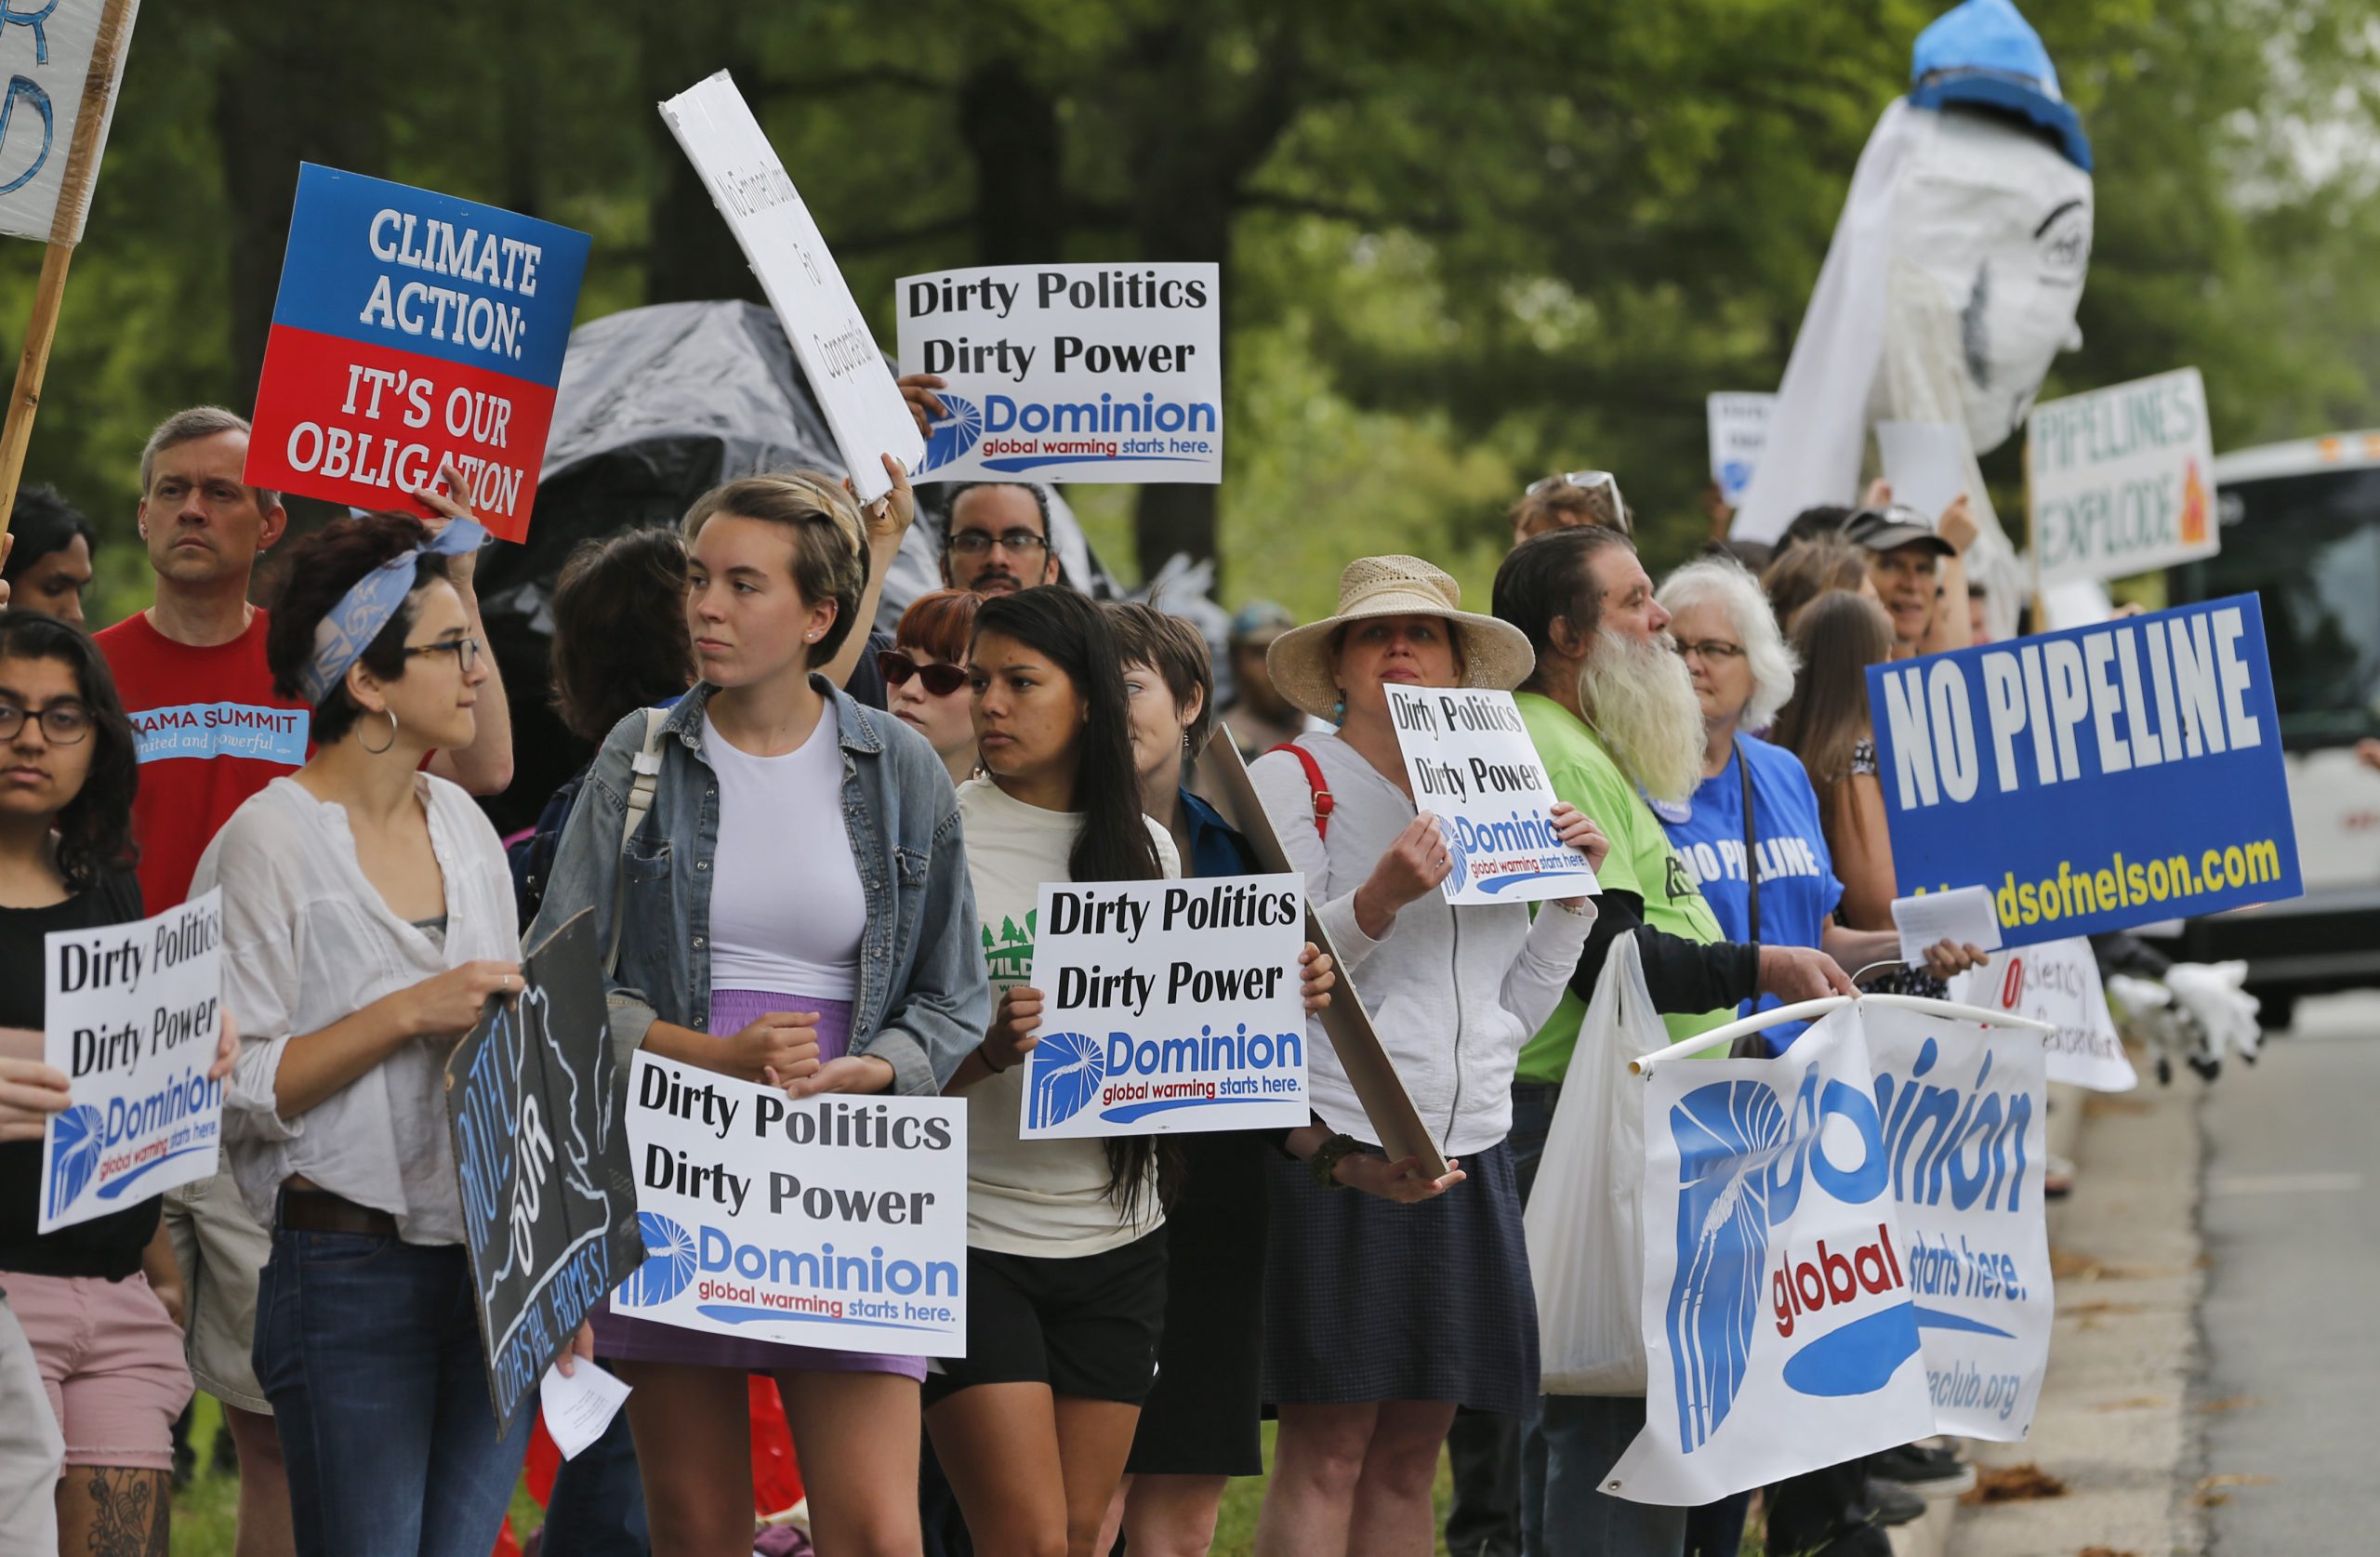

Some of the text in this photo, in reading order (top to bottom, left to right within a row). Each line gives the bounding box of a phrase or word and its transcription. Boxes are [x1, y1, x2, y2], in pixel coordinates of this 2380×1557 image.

[369, 207, 543, 298] CLIMATE
[360, 275, 526, 361] ACTION:
[907, 270, 1209, 319] Dirty Politics
[922, 336, 1037, 383] Dirty
[1053, 336, 1197, 374] Power
[341, 363, 512, 449] IT'S OUR
[983, 392, 1216, 433] Dominion
[286, 421, 524, 518] OBLIGATION
[983, 438, 1214, 457] global warming starts here.
[204, 707, 298, 734] SUMMIT
[1392, 693, 1523, 742] Dirty Politics
[1882, 606, 2262, 811] NO PIPELINE
[136, 732, 273, 754] nited and powerful
[1414, 757, 1543, 804] Dirty Power
[1454, 809, 1564, 854] Dominio
[1675, 837, 1820, 886] NO PILINE
[1470, 852, 1587, 878] global warming starts here.
[1913, 838, 2281, 929] dsofnelson.com
[1049, 883, 1297, 944] Dirty Politics
[60, 909, 219, 994] Dirty Politics
[1056, 961, 1283, 1018] Dirty Power
[72, 996, 217, 1078] Dirty Power
[1104, 1023, 1302, 1077] Dominion
[105, 1066, 222, 1148] Dominion
[639, 1062, 952, 1151] Dirty Politics
[1103, 1075, 1302, 1105] global warming starts here.
[99, 1150, 132, 1182] global
[133, 1137, 169, 1168] warming
[169, 1126, 192, 1151] starts
[1766, 1036, 2032, 1228] Doinion
[511, 1093, 555, 1277] OUR
[643, 1142, 935, 1226] Dirty Power
[698, 1224, 959, 1298] Dominion
[1772, 1223, 1904, 1339] global
[497, 1305, 555, 1419] COASTAL
[550, 1234, 610, 1342] HOMES!
[698, 1279, 957, 1323] global warming starts here.
[1926, 1359, 2020, 1421] aclub.org
